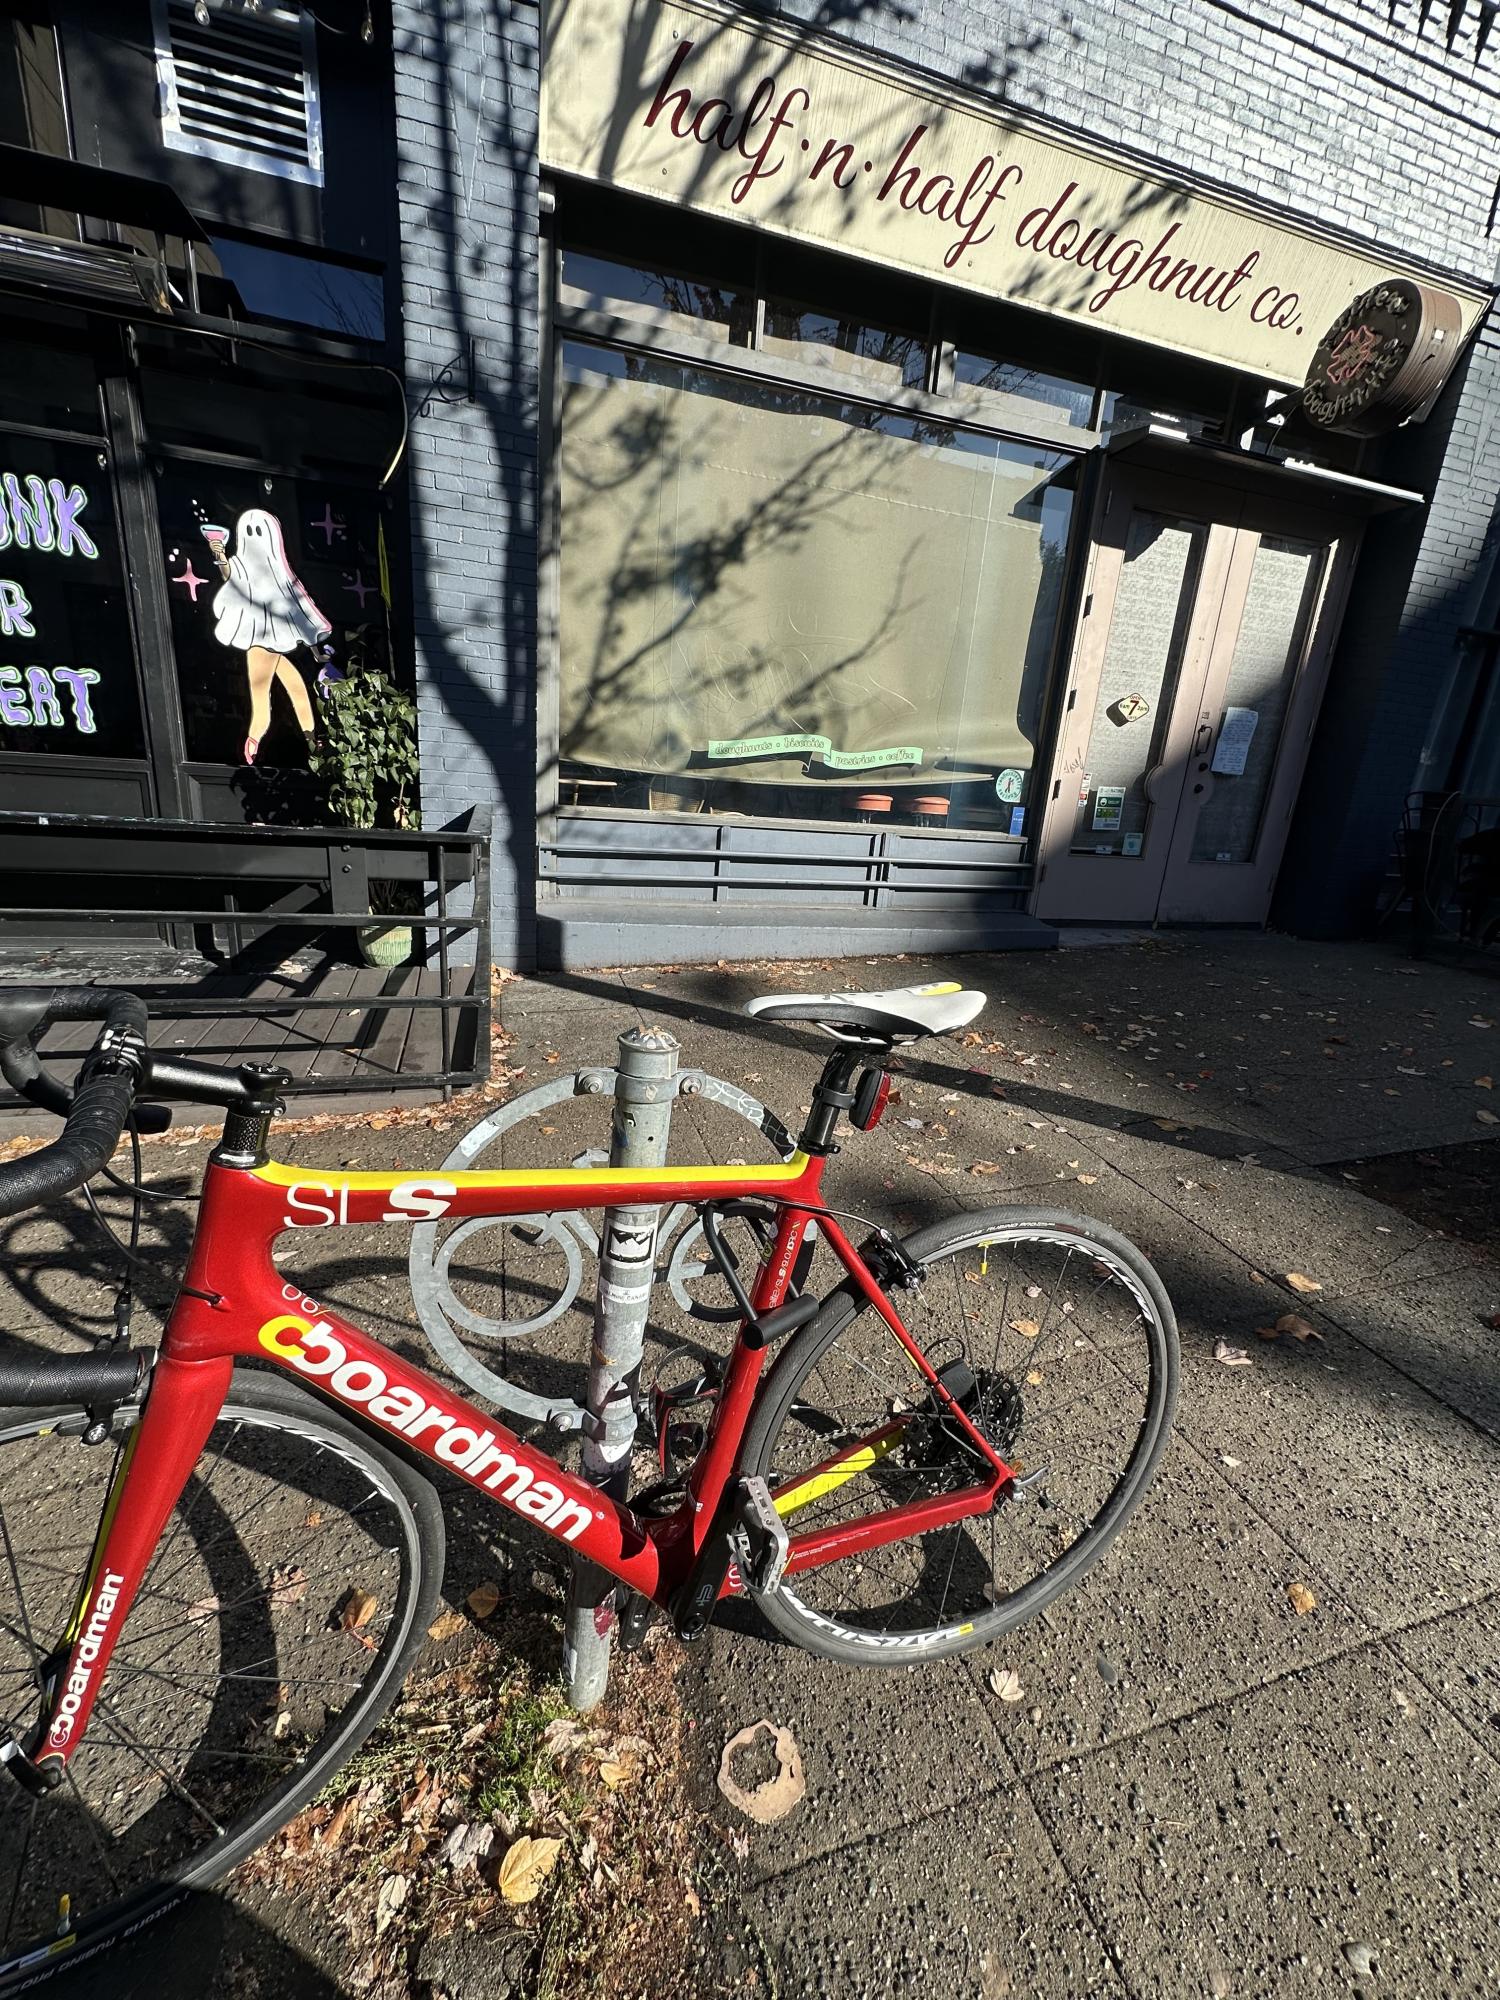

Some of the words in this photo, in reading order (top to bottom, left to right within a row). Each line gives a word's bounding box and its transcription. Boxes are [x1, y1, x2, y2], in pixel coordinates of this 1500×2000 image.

[1016, 183, 1263, 313] doughnut
[1250, 286, 1304, 336] co.
[1128, 699, 1139, 716] 7
[714, 742, 773, 755] doughnuts
[784, 736, 825, 749] biscuits
[834, 754, 876, 767] pastries
[885, 748, 914, 761] coffee
